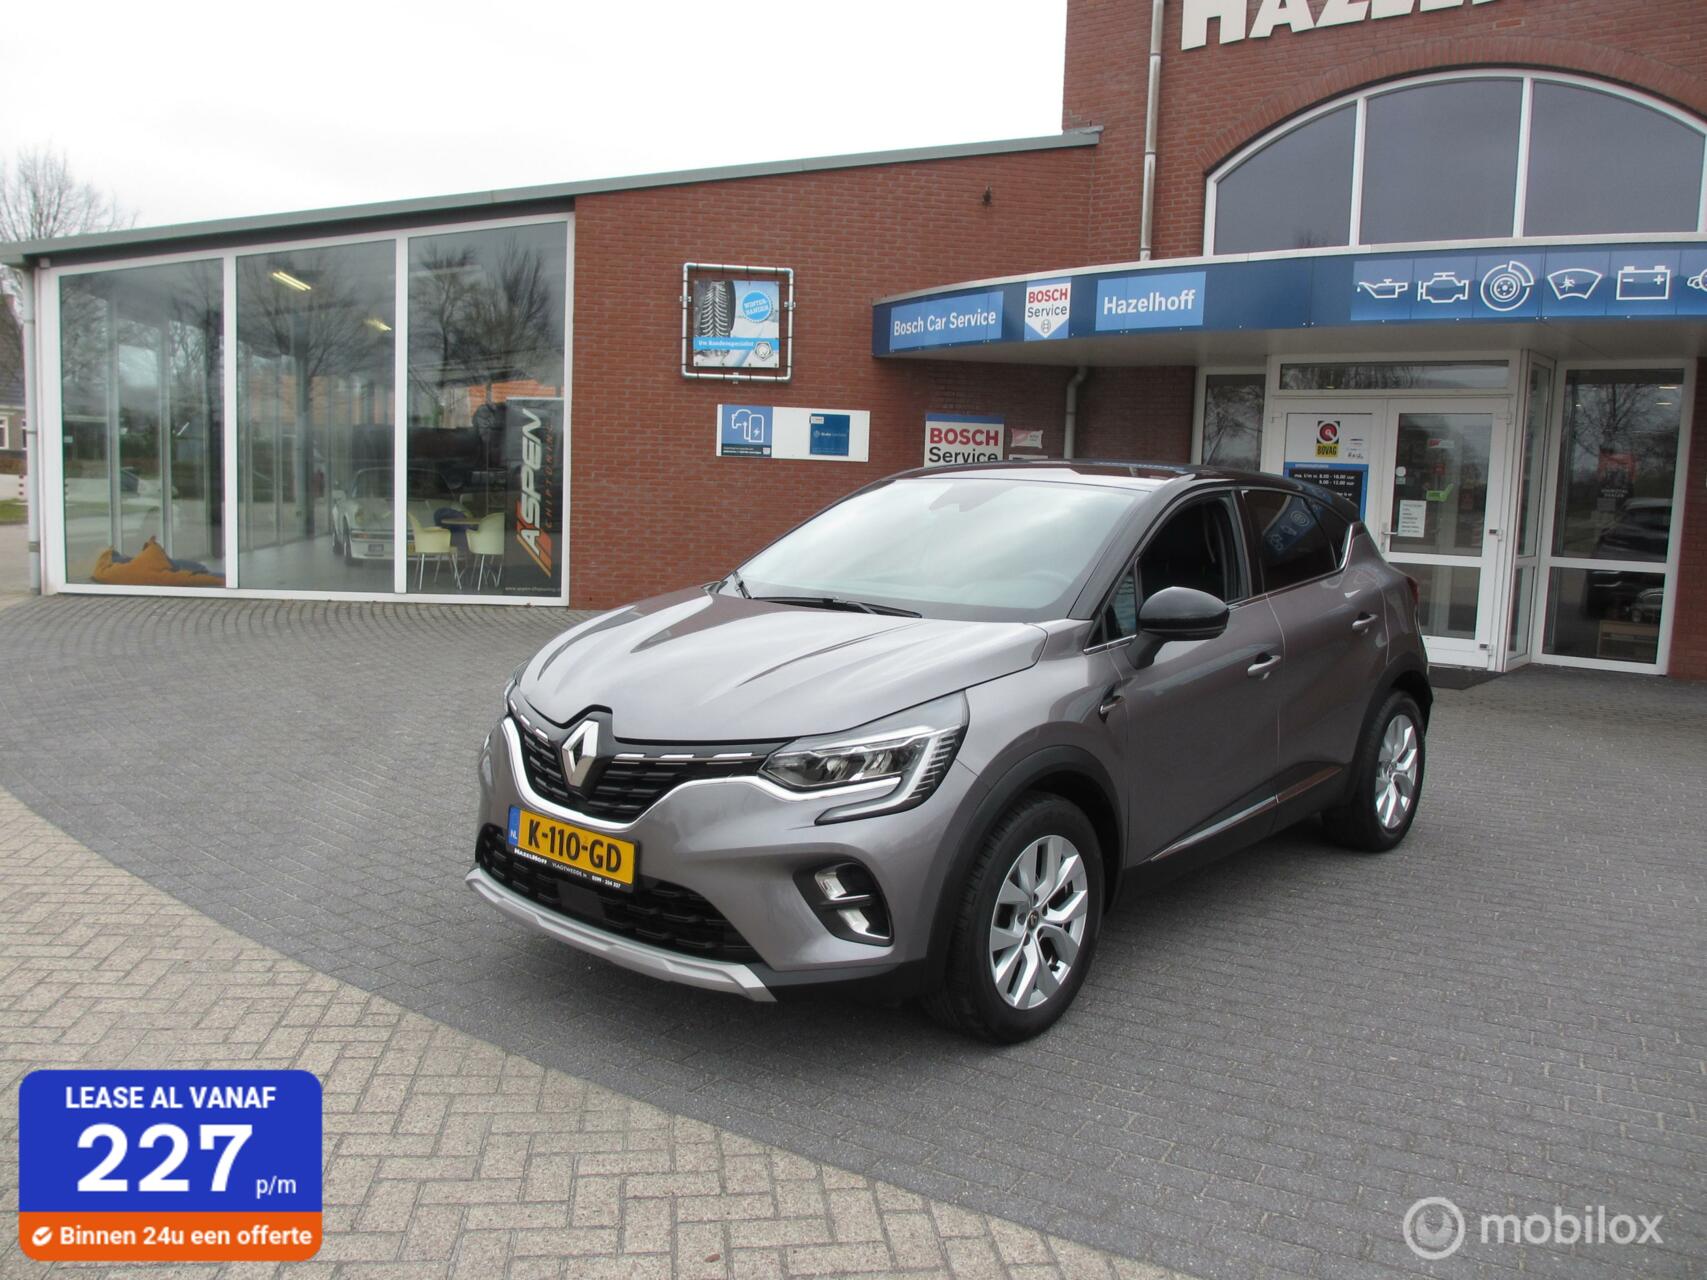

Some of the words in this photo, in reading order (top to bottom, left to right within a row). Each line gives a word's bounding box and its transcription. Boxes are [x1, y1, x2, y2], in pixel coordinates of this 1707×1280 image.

[1028, 287, 1068, 304] BOSCH
[1103, 289, 1196, 315] Hazelhoff
[1027, 304, 1068, 319] Service
[894, 319, 924, 336] Bosch
[927, 314, 947, 331] Car
[950, 308, 996, 327] Service
[930, 428, 999, 446] BOSCH
[929, 446, 998, 463] Service
[1317, 445, 1337, 456] BOVAG
[520, 408, 542, 557] ASPEN
[543, 424, 553, 529] CHIPTUNING
[510, 829, 518, 840] NL
[528, 818, 622, 873] K-110-GD
